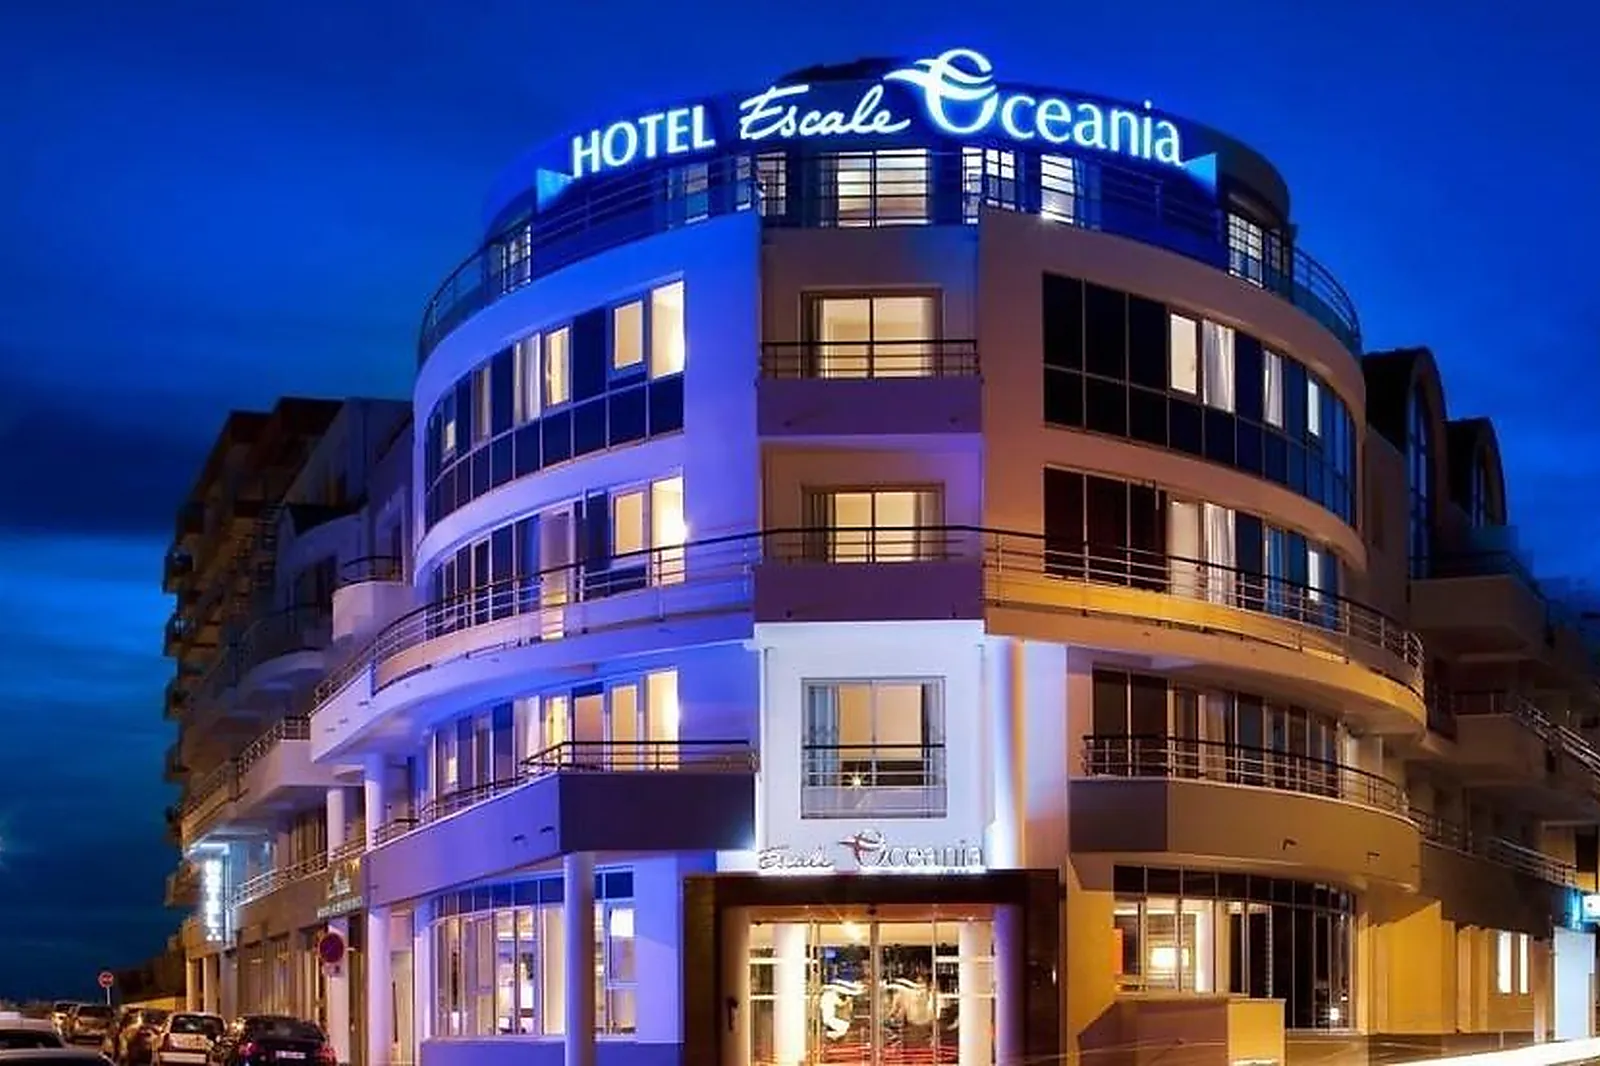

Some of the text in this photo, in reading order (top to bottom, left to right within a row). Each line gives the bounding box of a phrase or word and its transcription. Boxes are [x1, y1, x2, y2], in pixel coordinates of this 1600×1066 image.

[571, 48, 1184, 179] HOTEL Escale Oceania
[838, 828, 983, 868] Oceania
